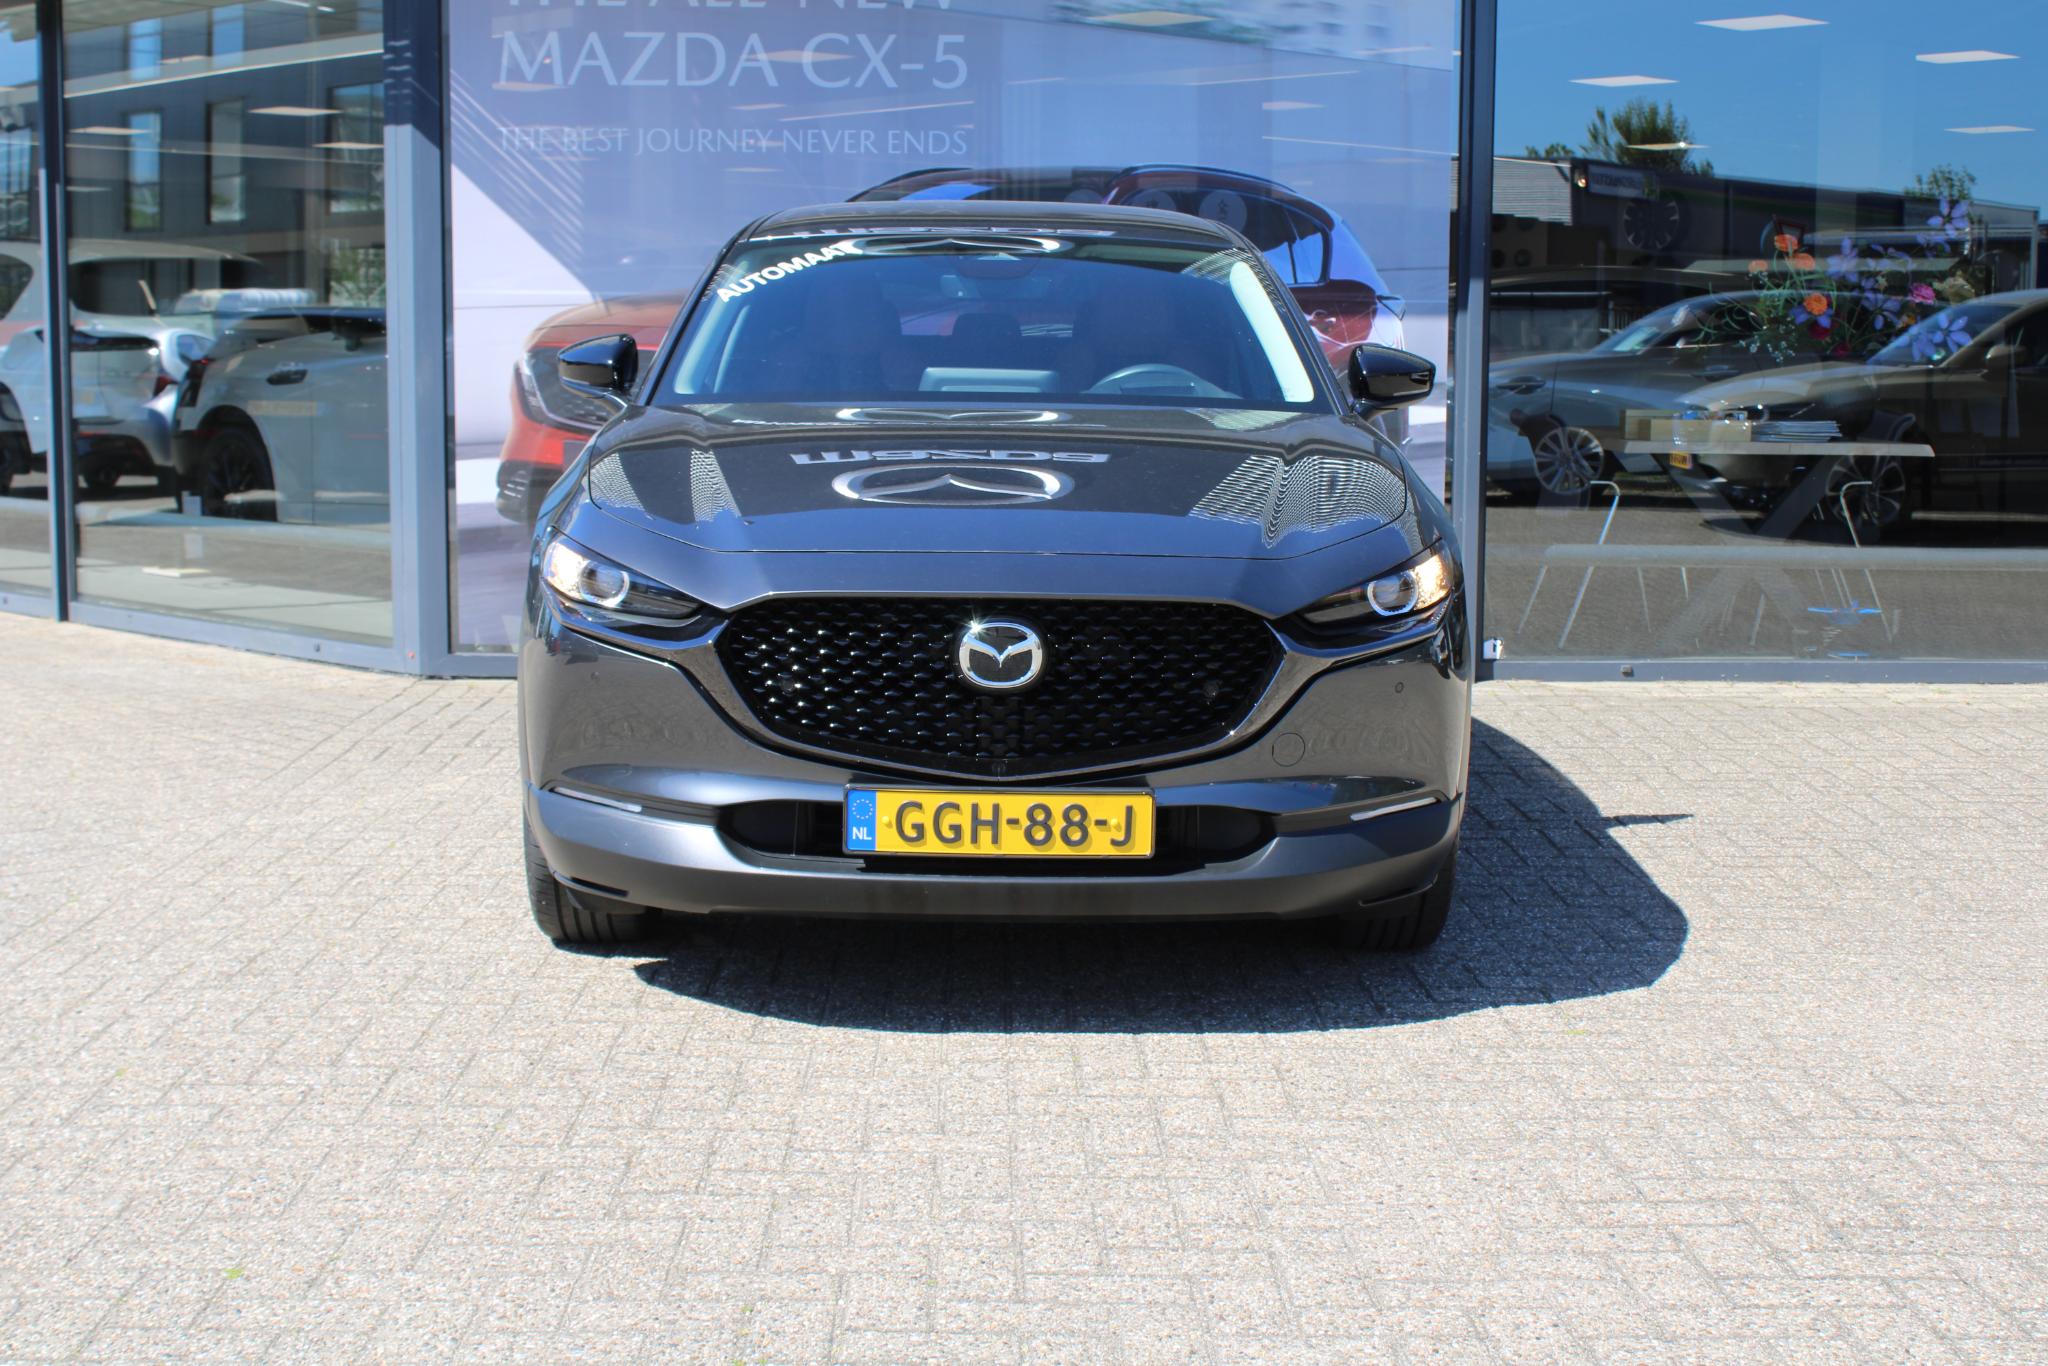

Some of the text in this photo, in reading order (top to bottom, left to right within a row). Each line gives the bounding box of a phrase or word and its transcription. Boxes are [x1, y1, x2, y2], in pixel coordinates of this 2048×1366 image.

[500, 31, 968, 89] MAZDA CX-5
[497, 126, 967, 156] THE BEST JOURNEY NEVER ENDS
[852, 826, 872, 841] NL
[895, 800, 1133, 847] GGH-88-J
